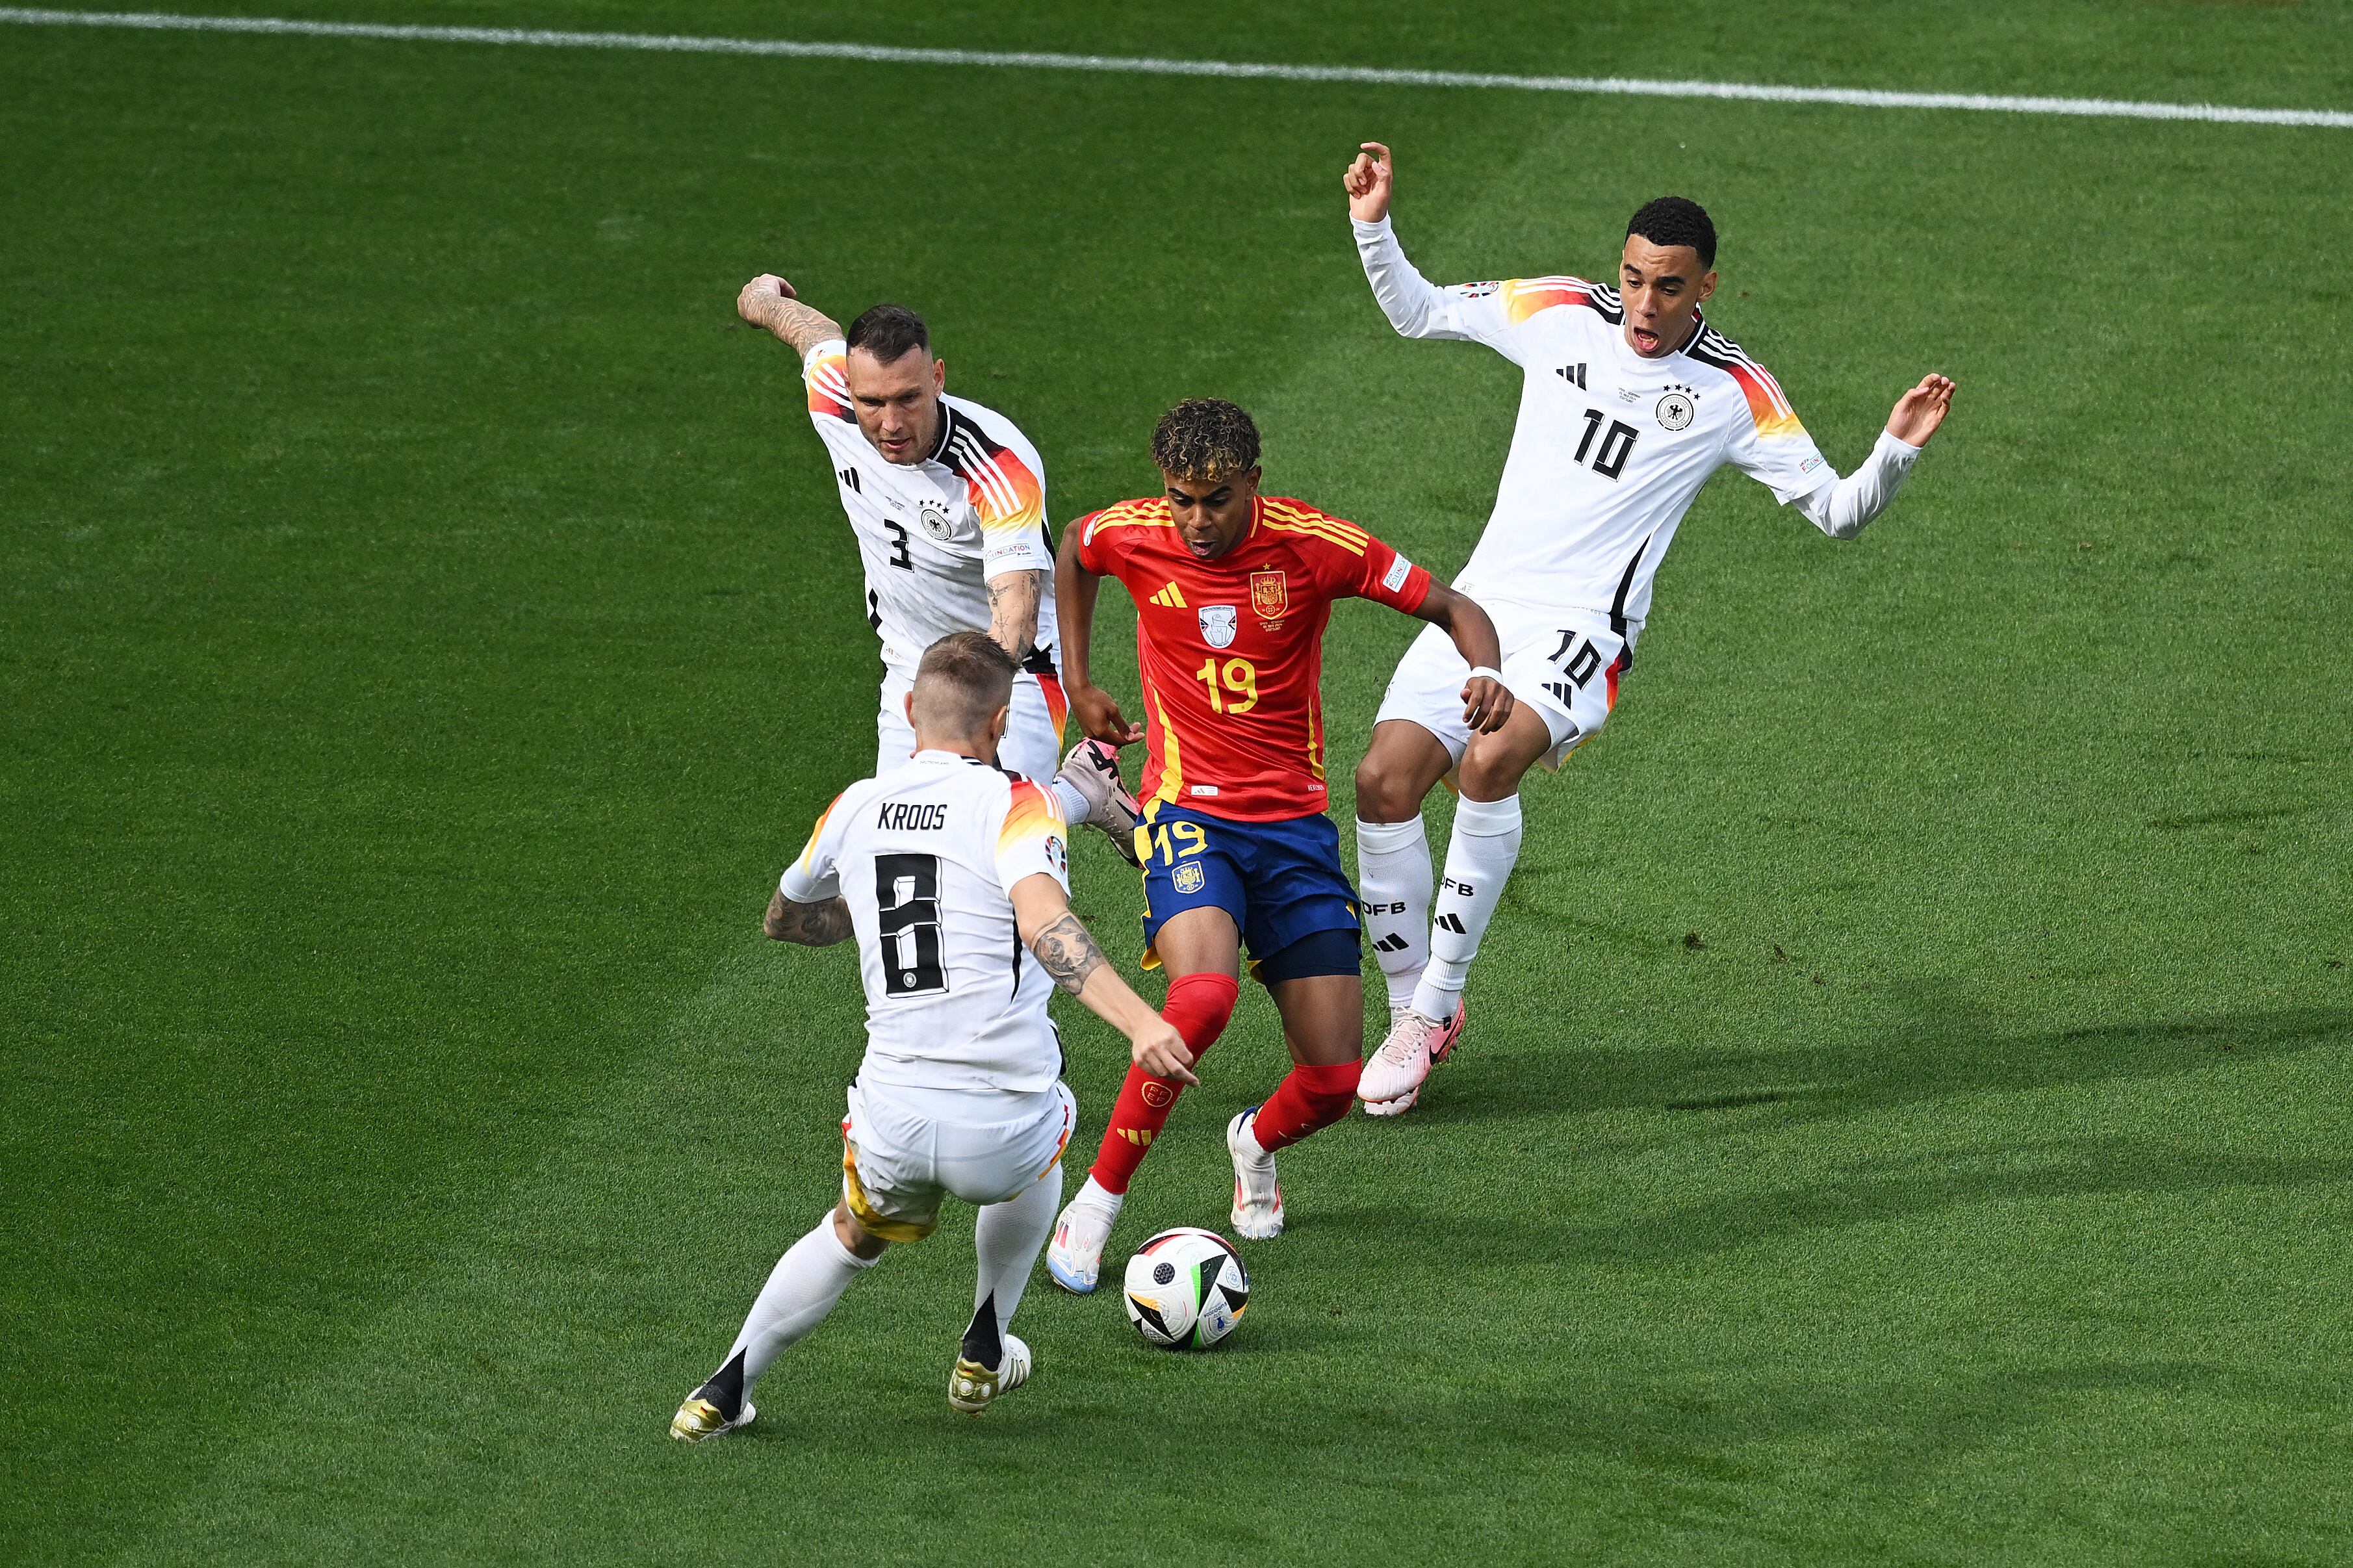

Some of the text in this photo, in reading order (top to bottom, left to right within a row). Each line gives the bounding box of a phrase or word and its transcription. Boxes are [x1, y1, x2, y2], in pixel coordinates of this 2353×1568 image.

[1574, 409, 1640, 482] 10
[884, 519, 914, 573] 3
[1196, 658, 1258, 713] 19
[1547, 629, 1602, 693] 10
[877, 803, 948, 830] KROOS
[1155, 821, 1208, 866] 19
[875, 853, 949, 999] 8
[1361, 900, 1406, 916] DFB
